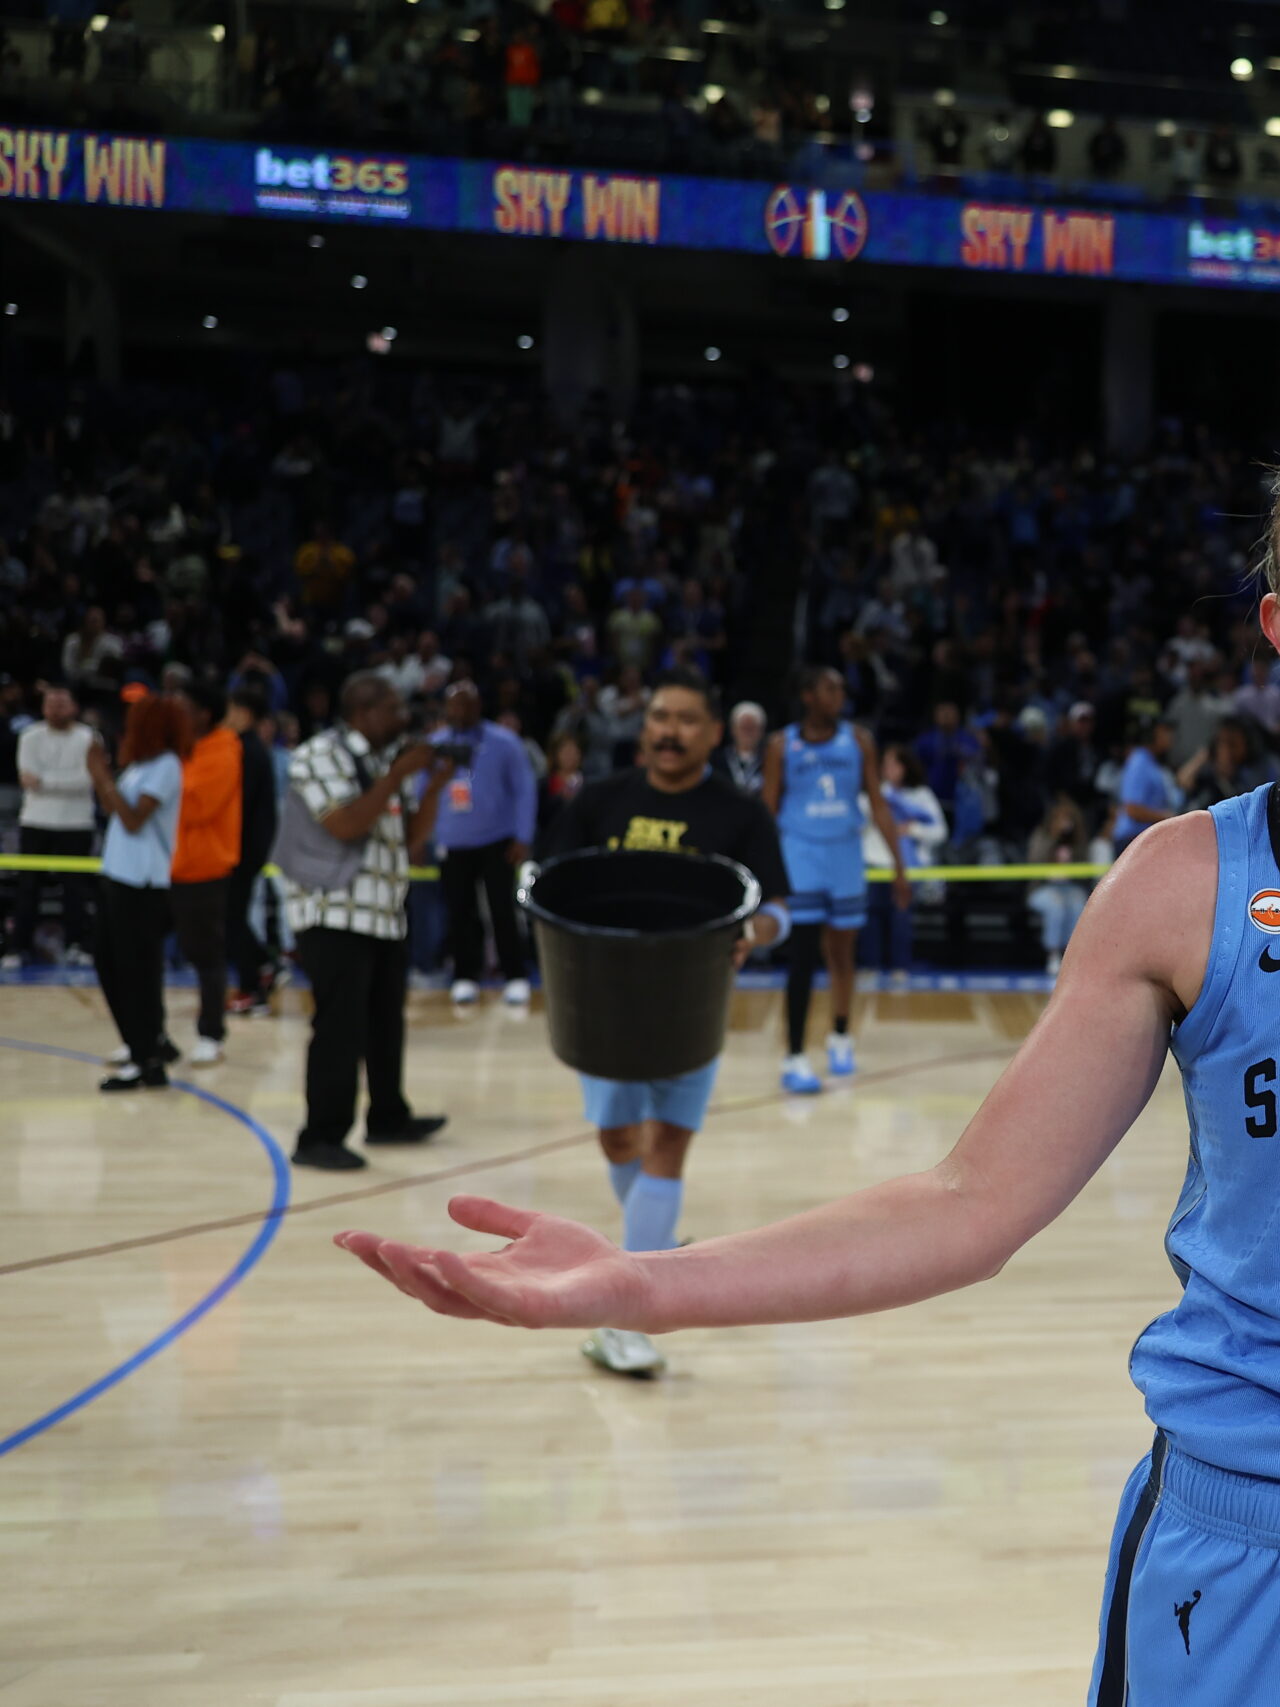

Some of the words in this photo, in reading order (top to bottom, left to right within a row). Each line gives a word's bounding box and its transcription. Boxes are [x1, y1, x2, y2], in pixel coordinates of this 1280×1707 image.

[0, 127, 69, 200] SKY
[84, 134, 165, 208] WIN
[255, 147, 409, 195] bet365
[494, 166, 573, 237] SKY
[582, 173, 660, 244] WIN
[961, 203, 1034, 270] SKY
[1042, 209, 1115, 276] WIN
